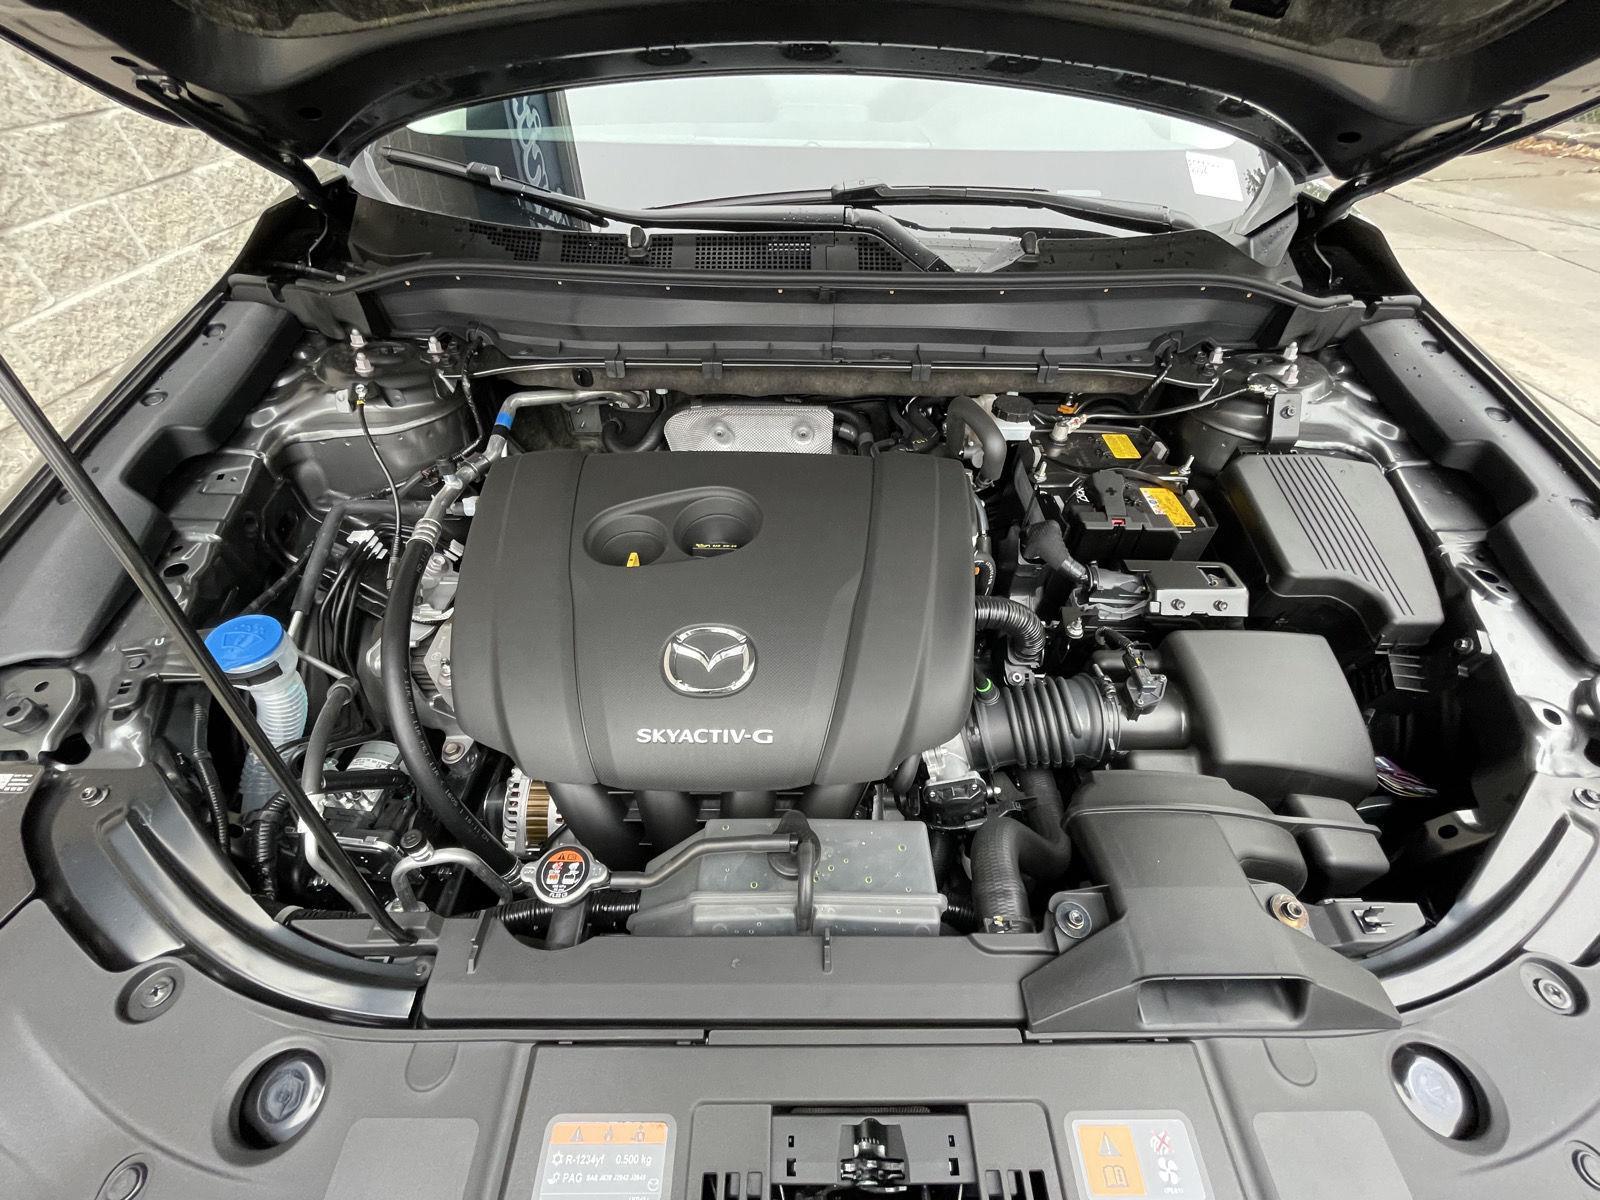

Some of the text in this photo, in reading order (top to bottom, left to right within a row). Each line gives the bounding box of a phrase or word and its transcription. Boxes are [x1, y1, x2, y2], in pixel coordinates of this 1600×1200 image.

[636, 728, 774, 744] SKYACTIV-G
[565, 1154, 652, 1167] R-1234yf 0.500 kg
[562, 1172, 583, 1183] PAG
